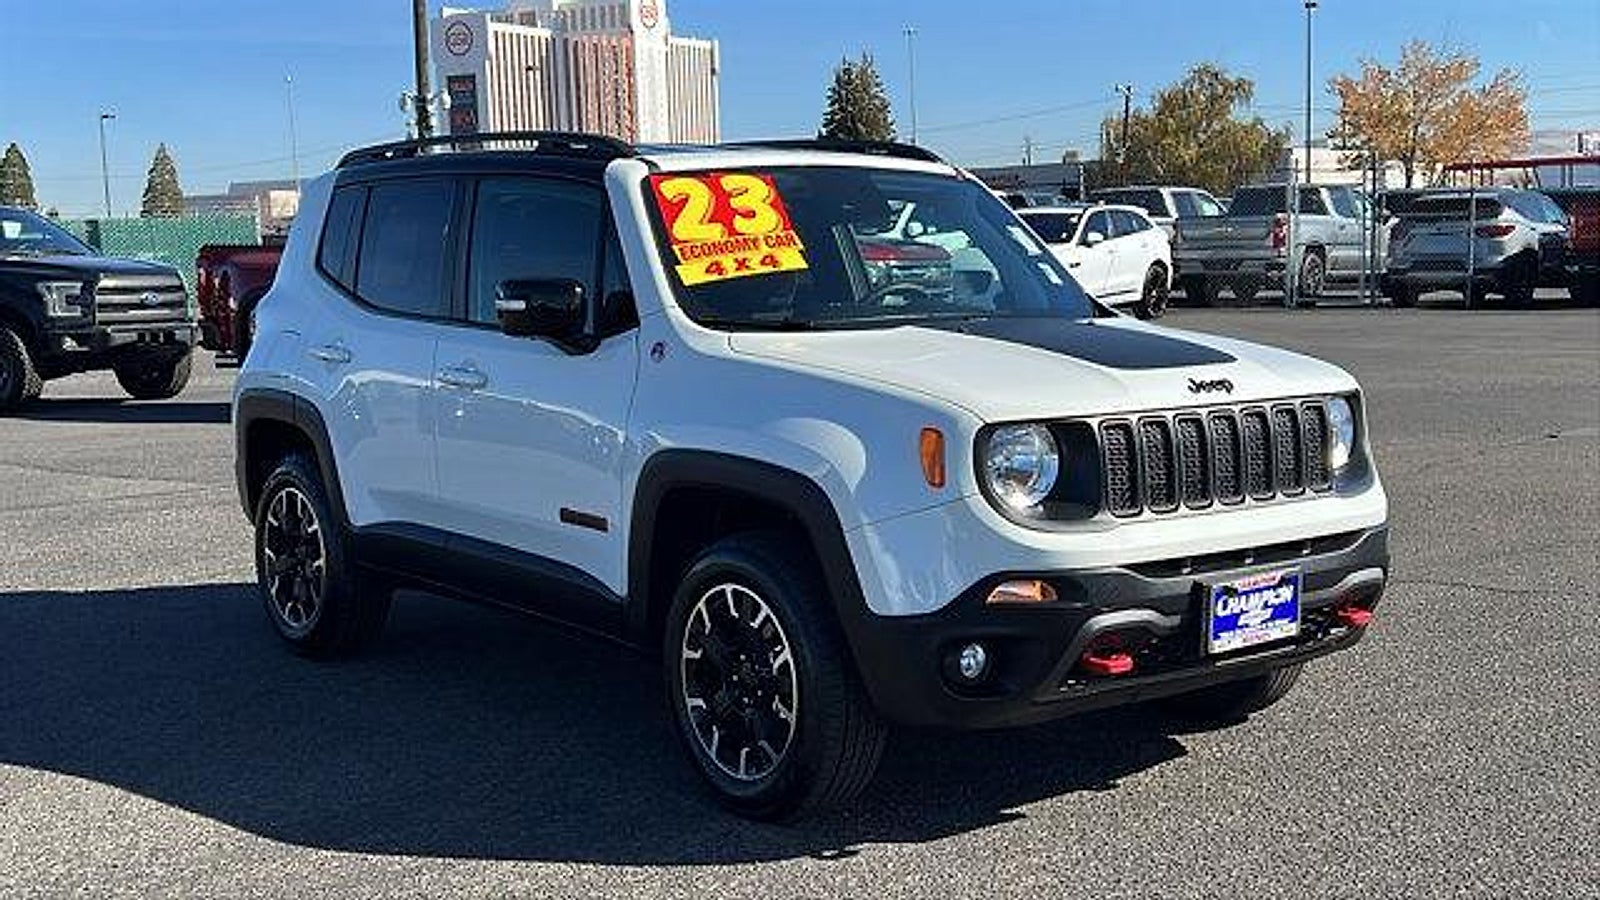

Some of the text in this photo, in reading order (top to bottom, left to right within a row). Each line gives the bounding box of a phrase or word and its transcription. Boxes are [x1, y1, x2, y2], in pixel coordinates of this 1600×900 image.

[659, 174, 783, 242] 23
[679, 233, 800, 261] ECONOMY CAR
[1187, 377, 1234, 395] Jeep
[1216, 584, 1295, 616] CHAMPION
